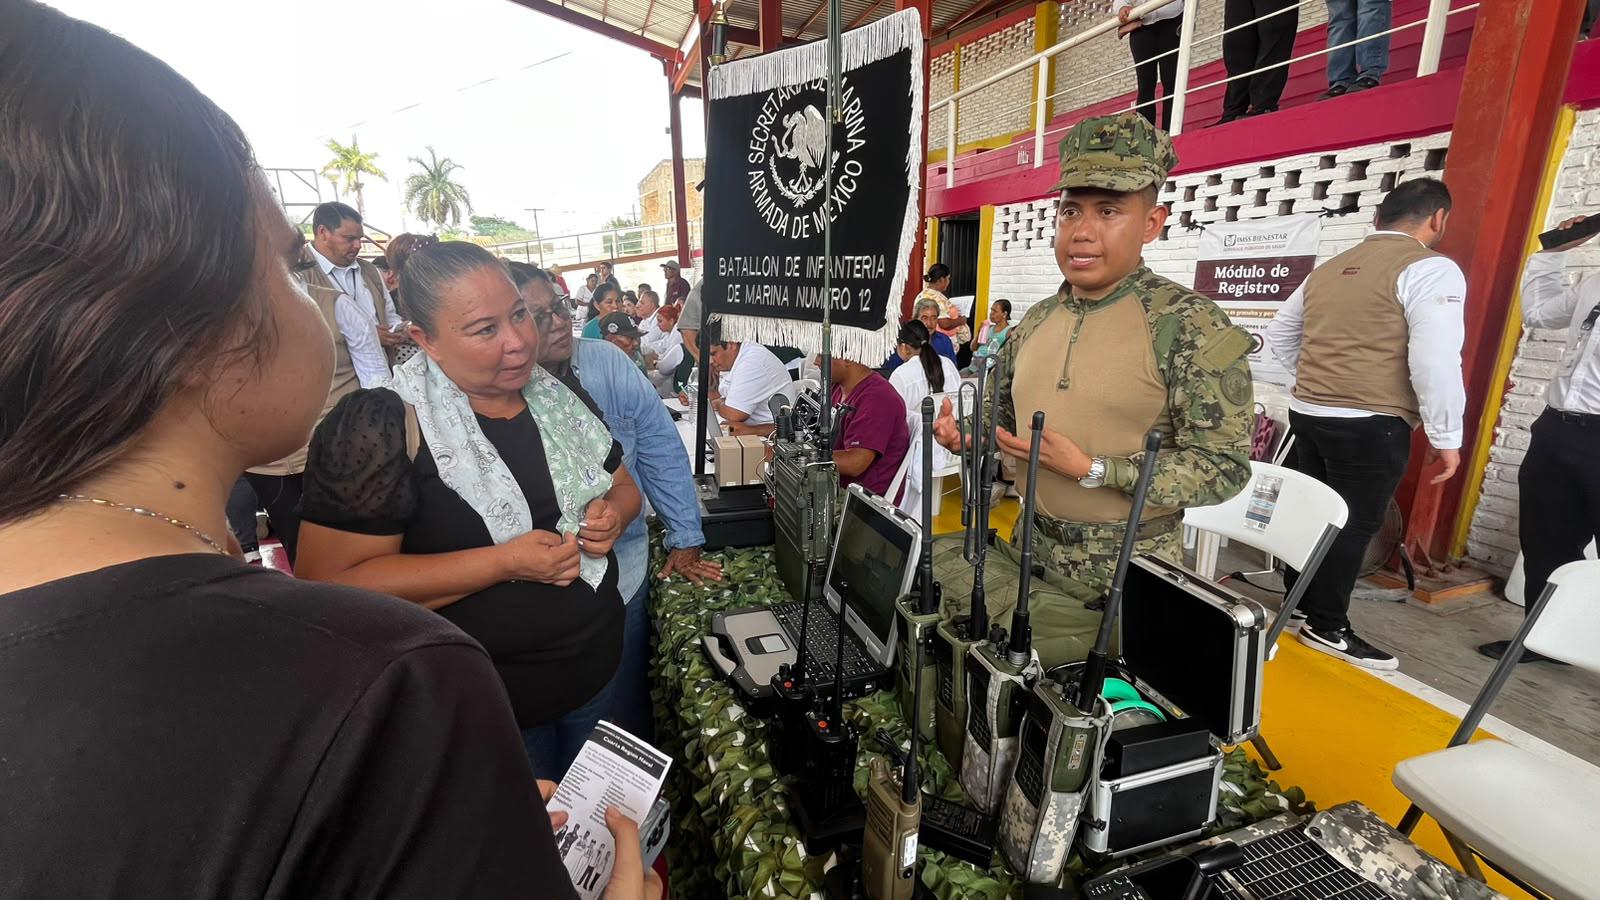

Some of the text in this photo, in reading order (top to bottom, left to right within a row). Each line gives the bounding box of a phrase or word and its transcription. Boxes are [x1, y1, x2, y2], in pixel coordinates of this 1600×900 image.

[748, 170, 790, 237] ARMADA
[791, 215, 810, 239] DE
[1252, 233, 1288, 242] BIENESTAR
[718, 255, 780, 278] BATALLON
[785, 256, 801, 278] DE
[1214, 263, 1290, 279] Módulo de
[727, 284, 872, 312] DE MARINA NUMRO 12
[1218, 280, 1280, 297] Registro
